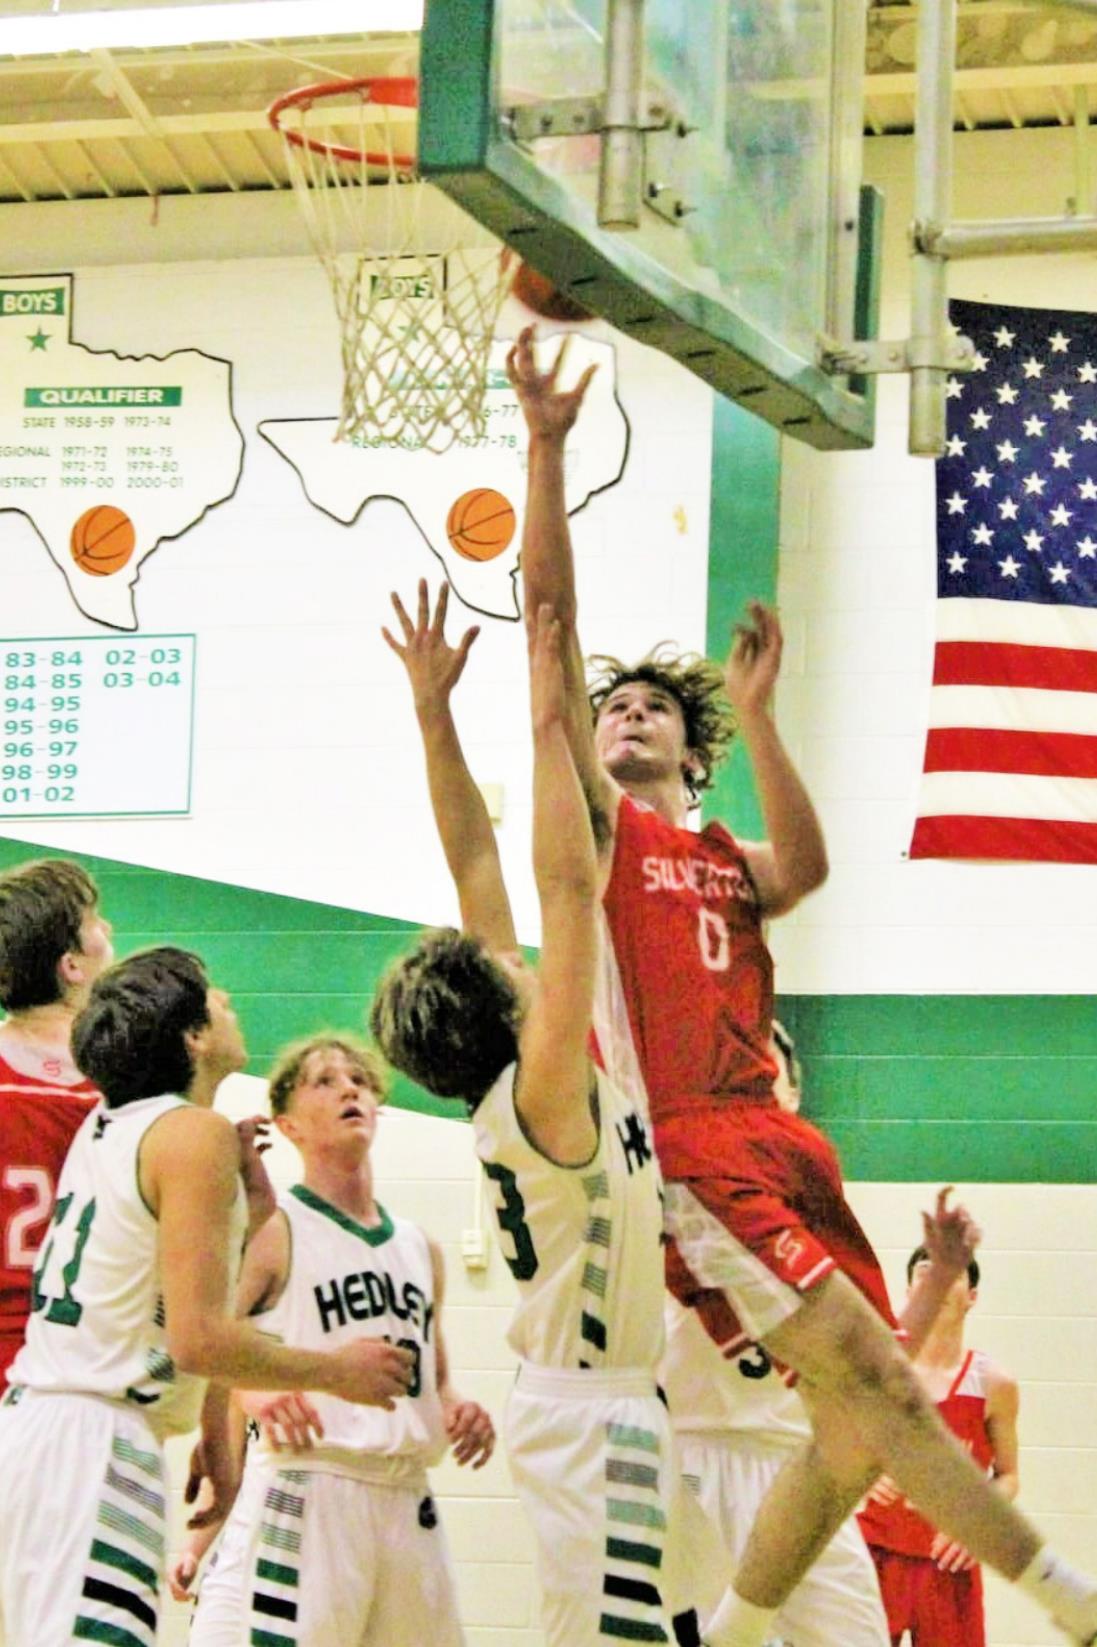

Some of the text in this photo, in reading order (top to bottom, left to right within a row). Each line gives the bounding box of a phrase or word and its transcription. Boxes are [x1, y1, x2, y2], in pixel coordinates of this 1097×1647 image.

[376, 279, 432, 297] OYS
[3, 293, 56, 312] BOYS
[40, 389, 164, 404] QUALIFIER
[22, 416, 57, 428] STATE
[65, 416, 115, 429] 1958-59
[61, 477, 114, 488] 1999-00
[128, 477, 183, 488] 2000-01
[6, 649, 181, 667] 83-84 02-03
[5, 672, 180, 690] 84-85 03-04
[5, 696, 81, 713] 94-95
[4, 719, 79, 735] 95-96
[4, 741, 78, 757] 96-97
[2, 764, 78, 780] 98-99
[2, 787, 75, 802] 01-02
[698, 907, 730, 972] 0
[313, 1271, 434, 1344] HEDLEY
